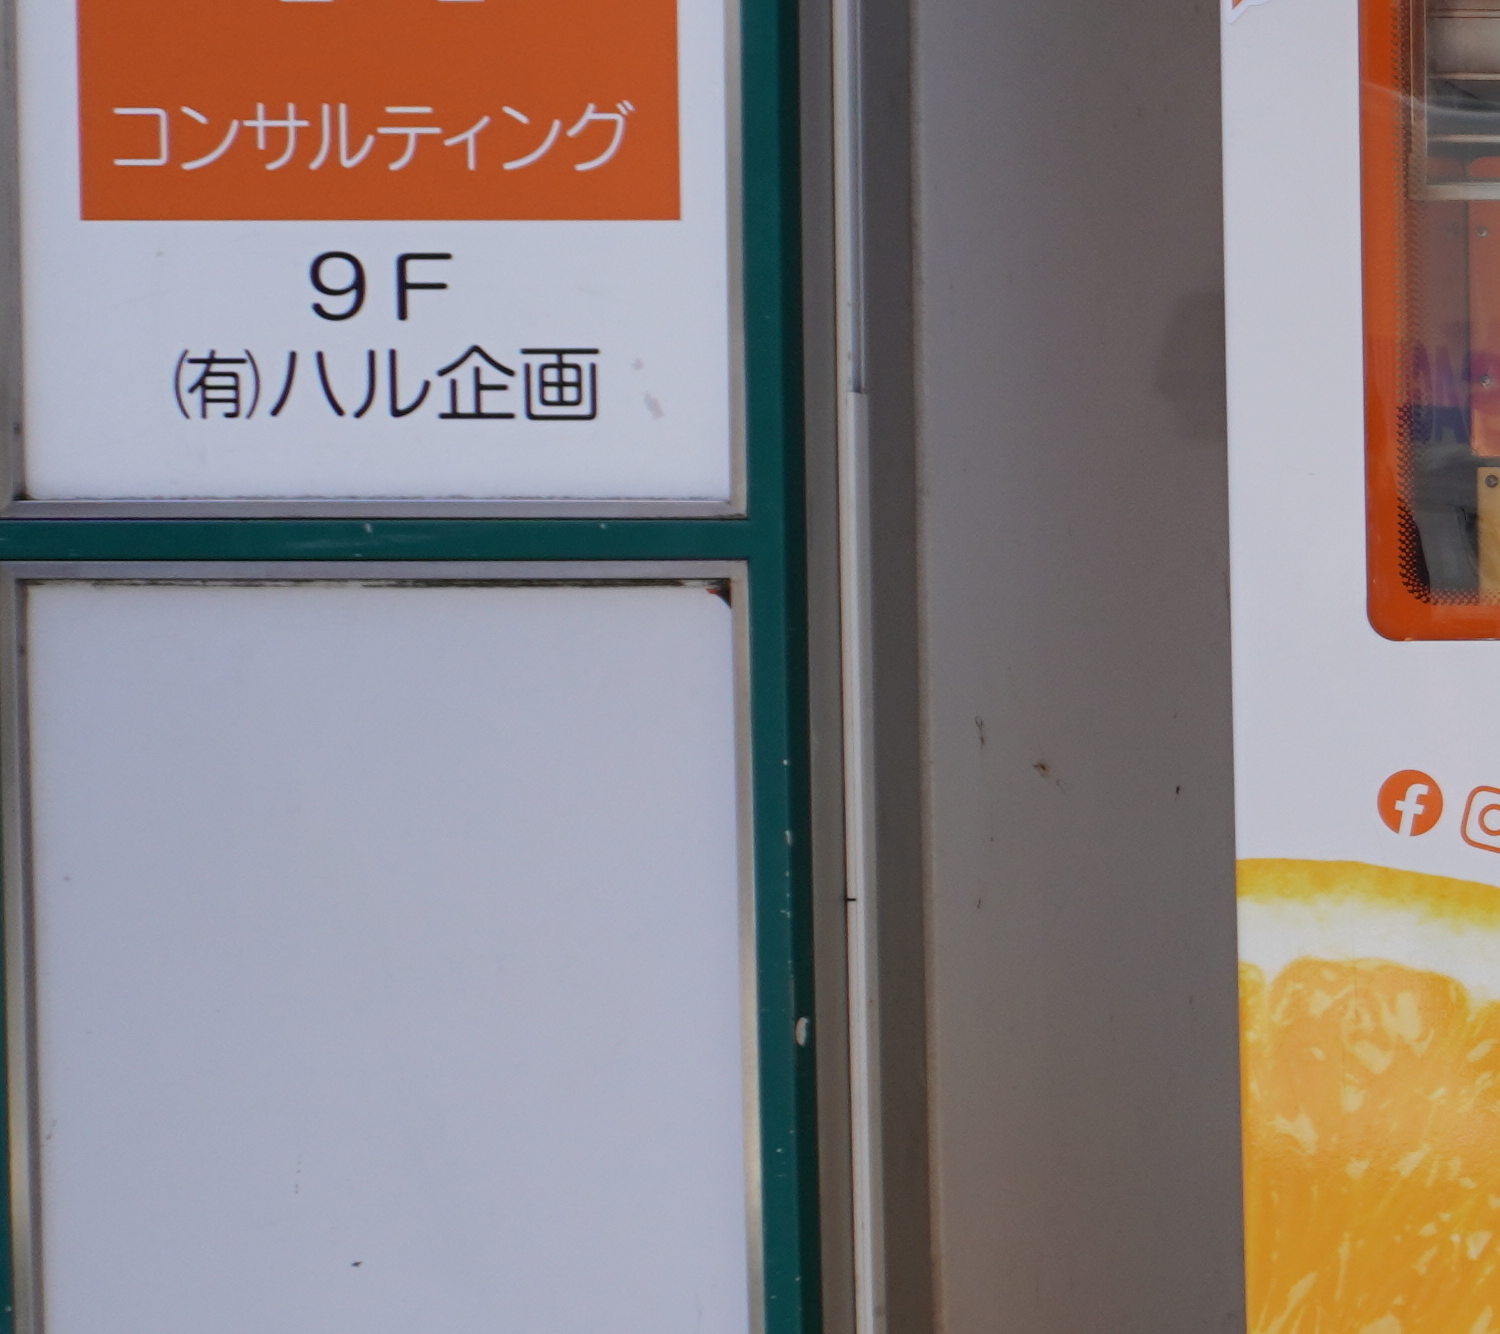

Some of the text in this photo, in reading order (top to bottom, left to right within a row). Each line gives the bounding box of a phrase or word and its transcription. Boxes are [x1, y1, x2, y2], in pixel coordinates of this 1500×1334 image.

[114, 101, 634, 171] コンサルティング
[309, 251, 451, 322] 9F
